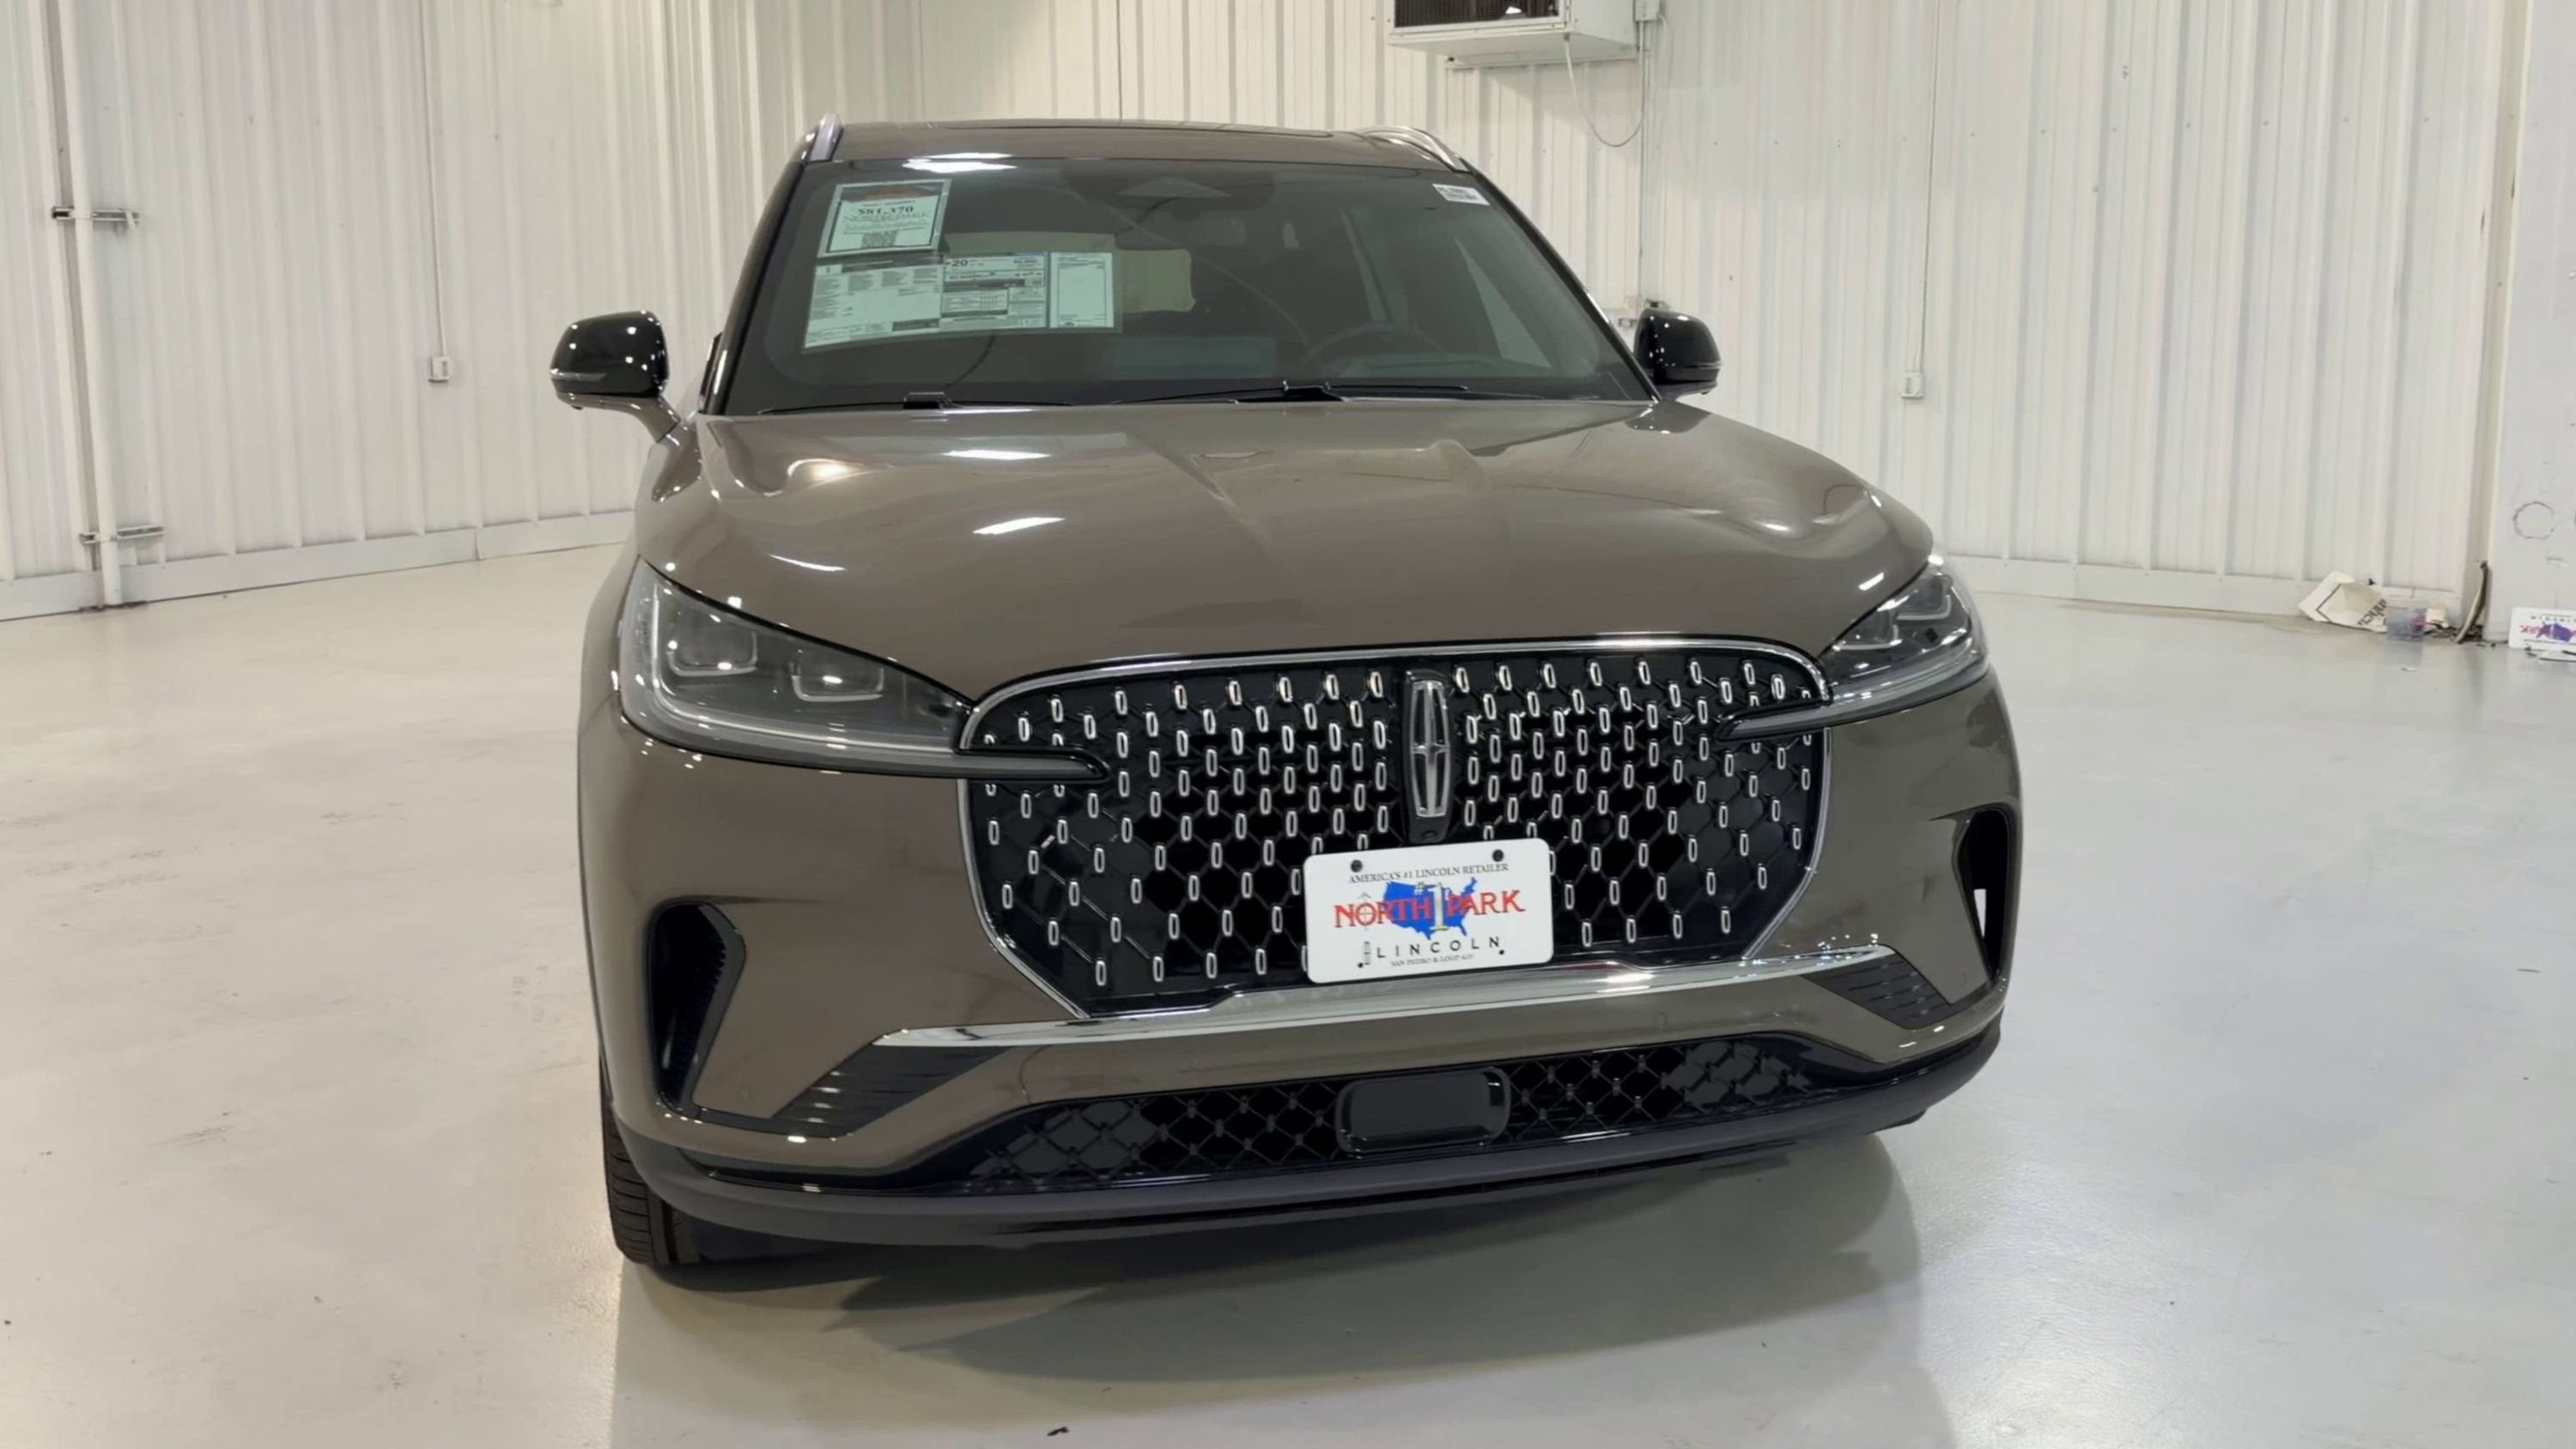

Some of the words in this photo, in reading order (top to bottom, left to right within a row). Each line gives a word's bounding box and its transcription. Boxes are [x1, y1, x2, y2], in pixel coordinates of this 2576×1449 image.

[1415, 866, 1460, 878] LINCOLN
[1462, 863, 1509, 874] RETAILER
[1334, 897, 1431, 928] NORTH
[1448, 890, 1525, 916] PARK
[1376, 937, 1499, 958] LINCOLN
